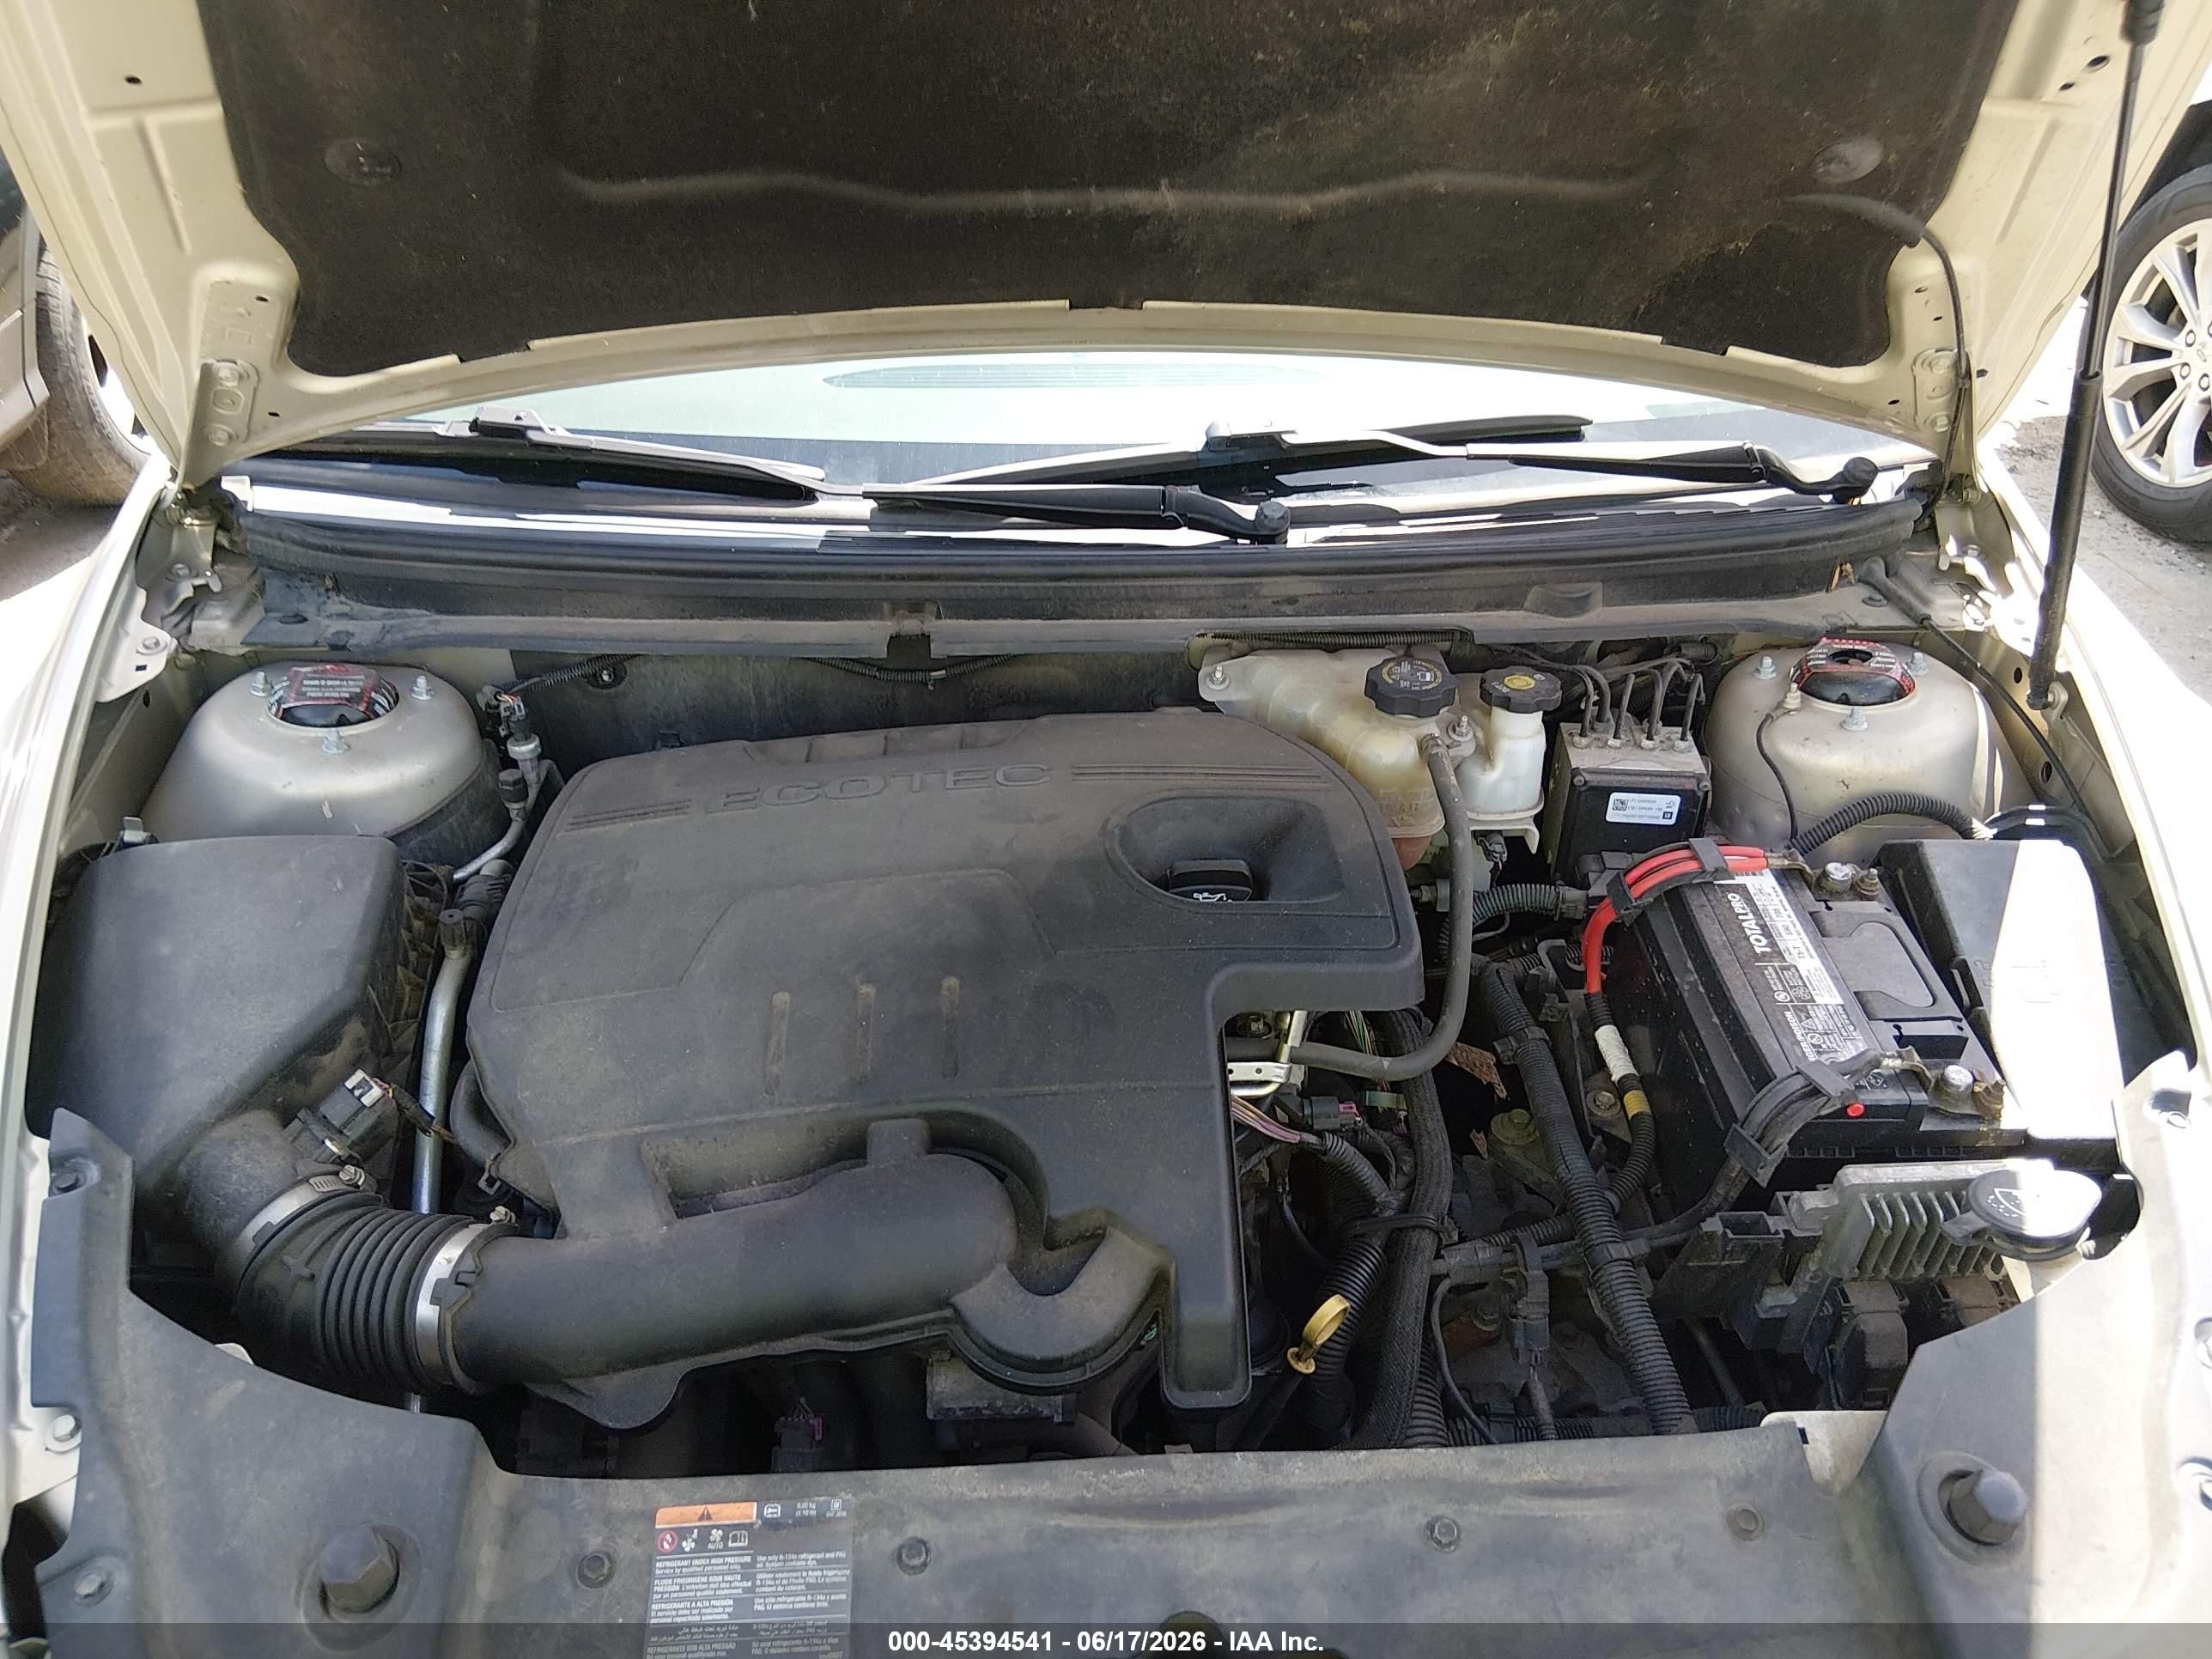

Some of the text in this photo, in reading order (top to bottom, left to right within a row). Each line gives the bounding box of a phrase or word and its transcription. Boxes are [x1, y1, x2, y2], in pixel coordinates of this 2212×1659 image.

[706, 763, 1051, 814] ECOTEC
[655, 1559, 691, 1568] REFRIGERANT
[691, 1558, 710, 1566] UNDER
[724, 1555, 752, 1564] PRESSURE
